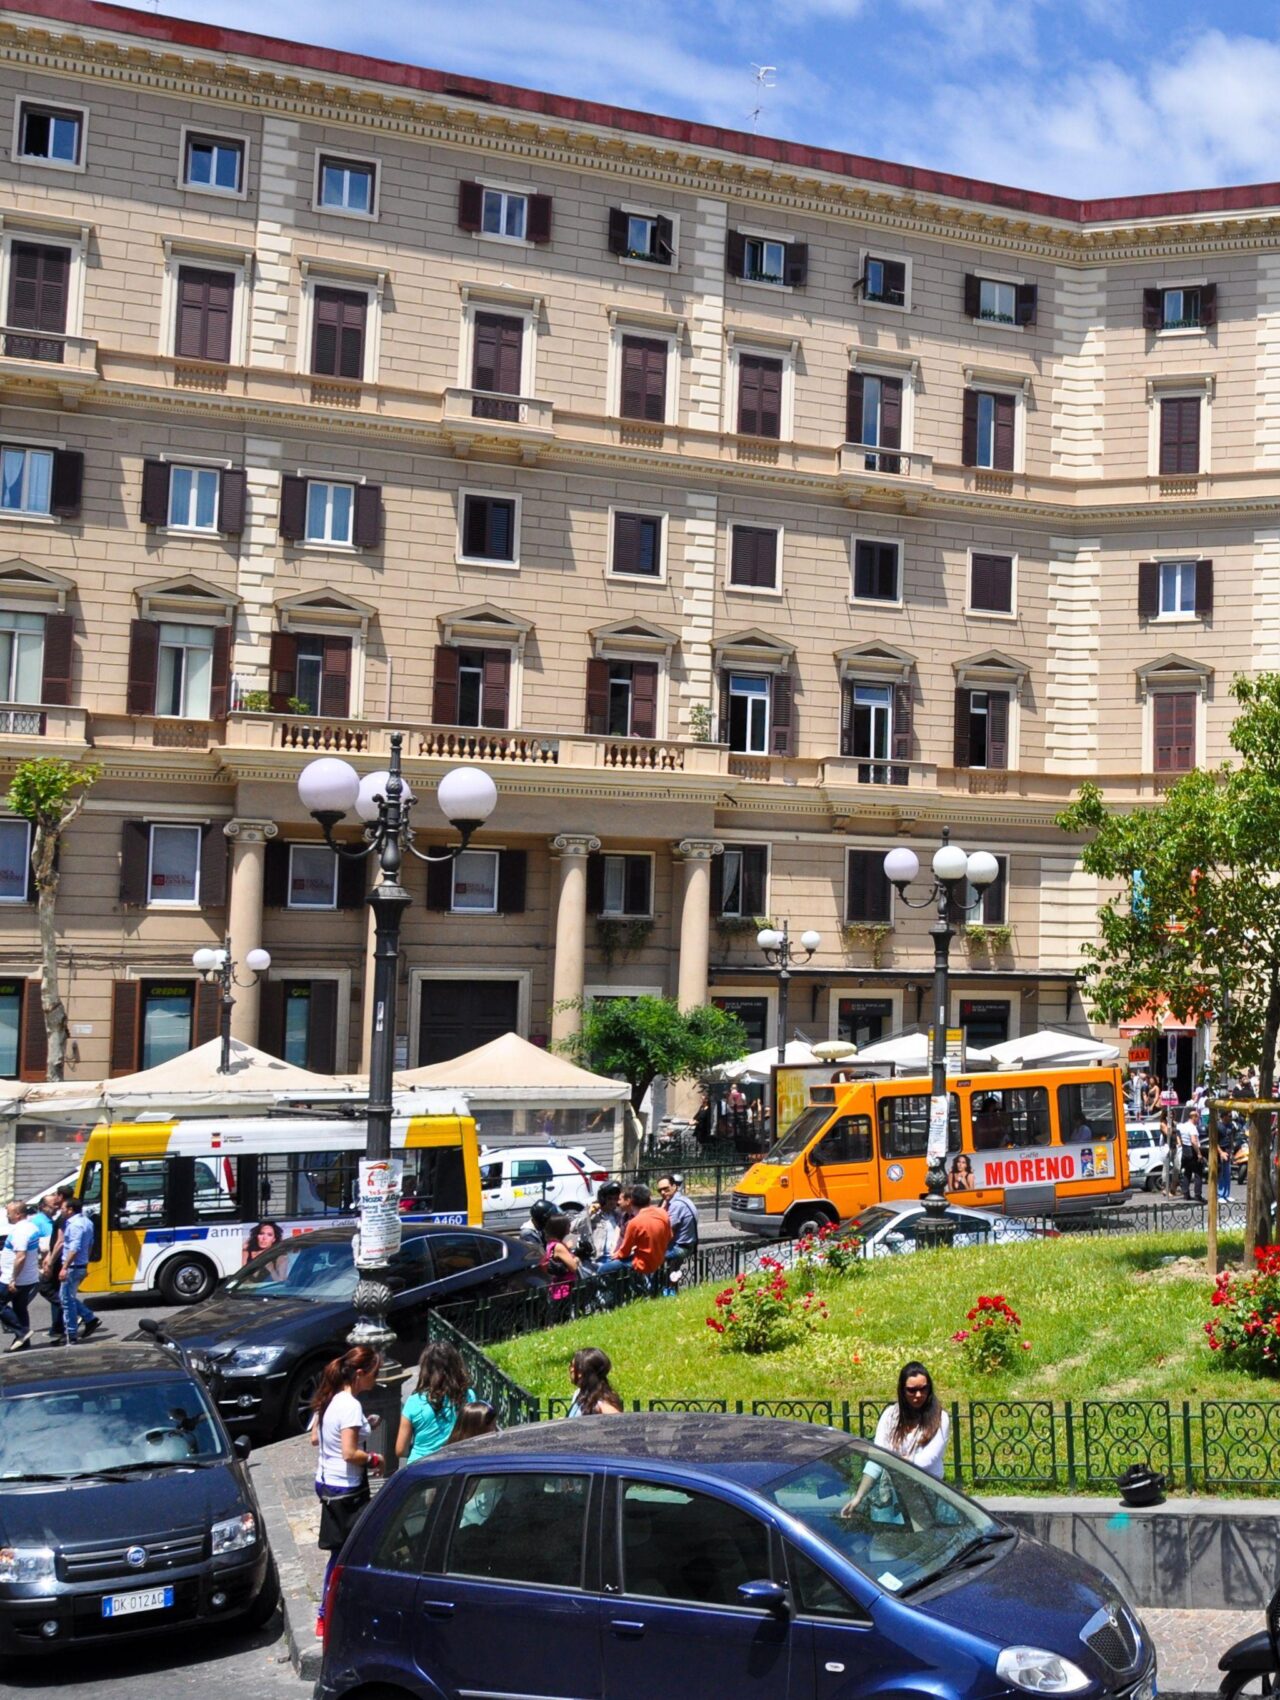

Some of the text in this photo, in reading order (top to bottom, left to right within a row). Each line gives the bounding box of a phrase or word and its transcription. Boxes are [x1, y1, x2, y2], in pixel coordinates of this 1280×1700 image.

[1130, 1050, 1149, 1060] TAXI
[985, 1155, 1075, 1186] MORENO
[434, 1215, 463, 1226] A460
[114, 1597, 127, 1612] DK
